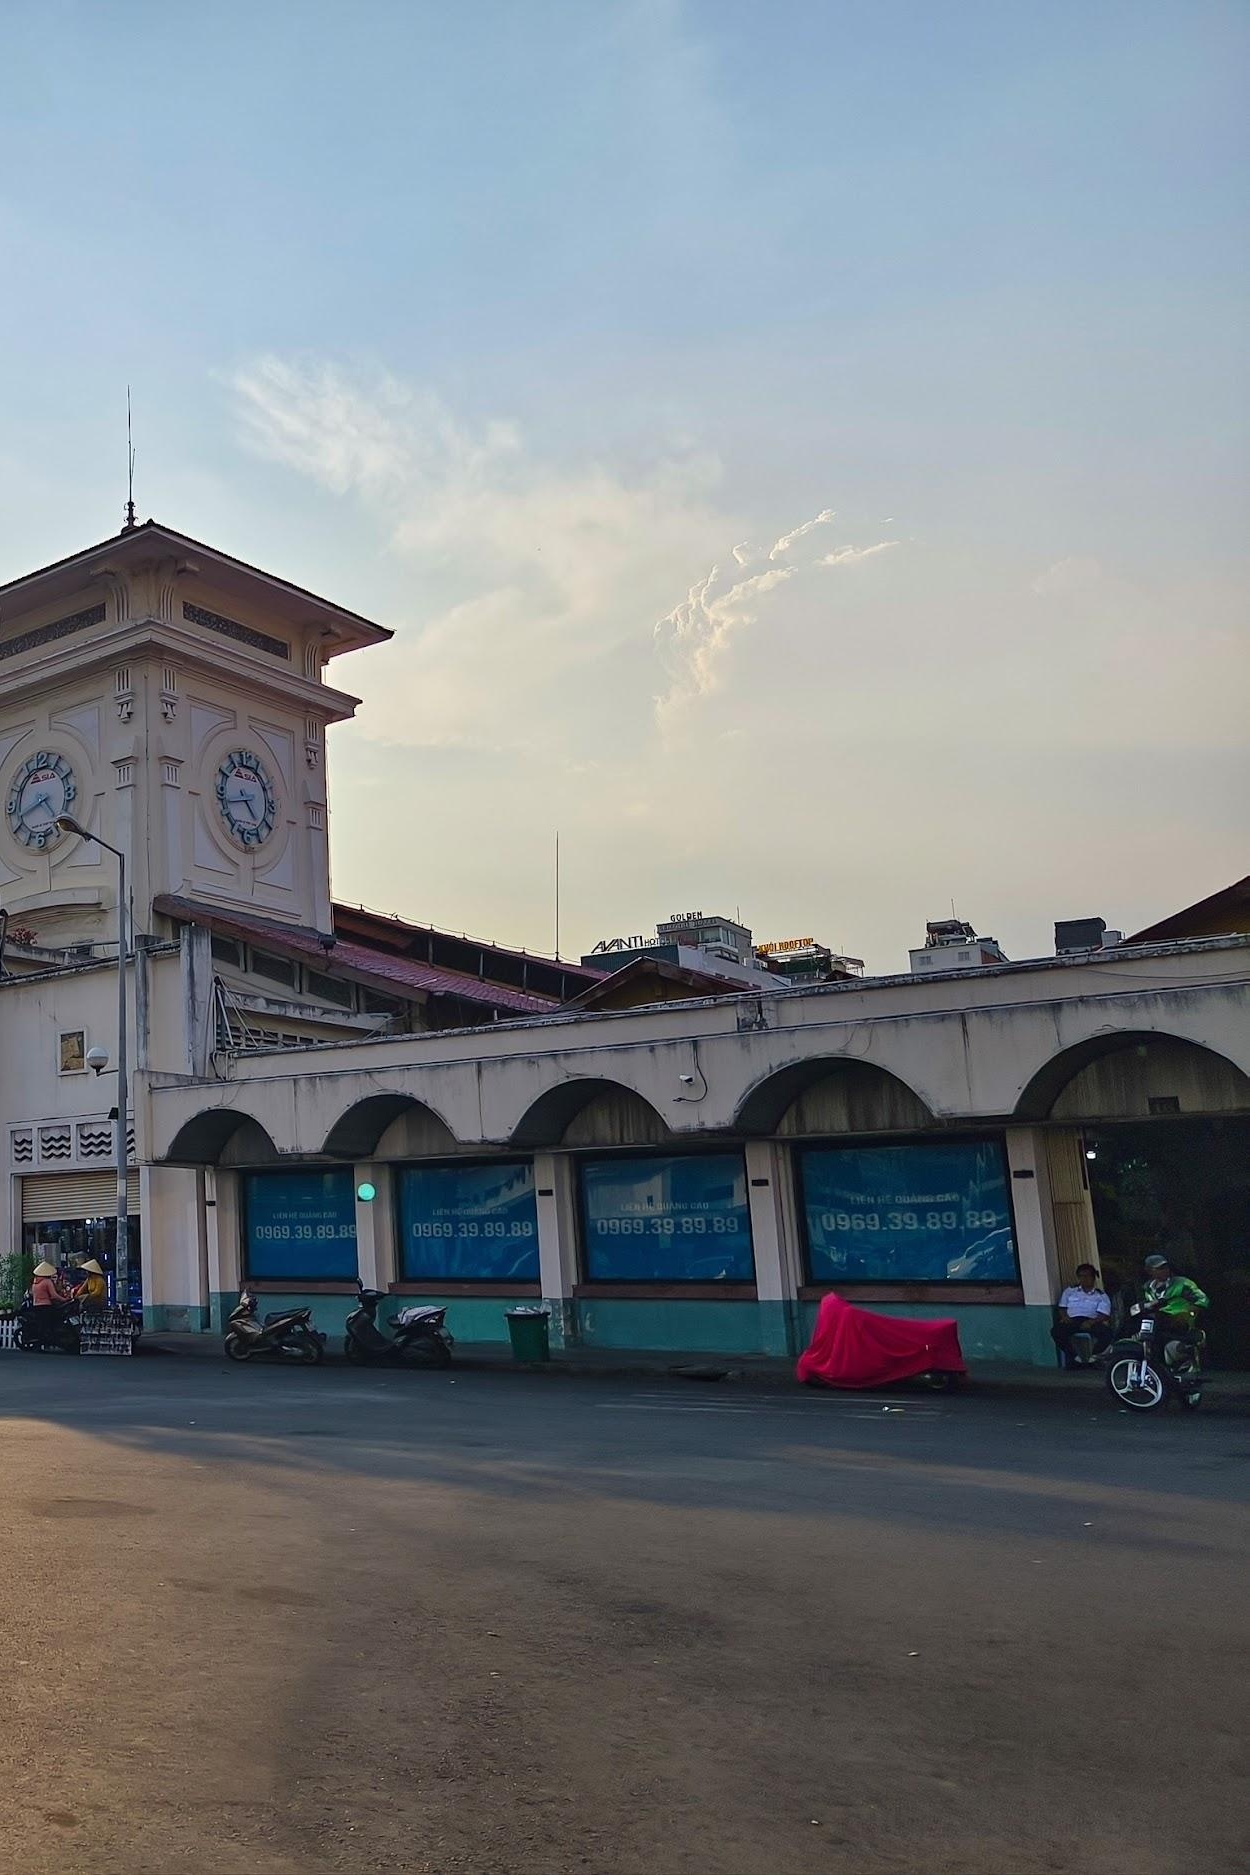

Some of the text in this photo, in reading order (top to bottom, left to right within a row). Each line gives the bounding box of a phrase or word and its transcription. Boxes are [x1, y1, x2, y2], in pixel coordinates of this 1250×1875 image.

[6, 799, 17, 815] 9
[35, 832, 46, 848] 6
[670, 910, 703, 922] GOLDEN
[591, 935, 644, 954] AVANTI
[255, 1224, 357, 1239] 0969.39.89.89
[412, 1221, 533, 1238] 0969.39.89.89
[597, 1216, 739, 1235] 0969.39.89.89
